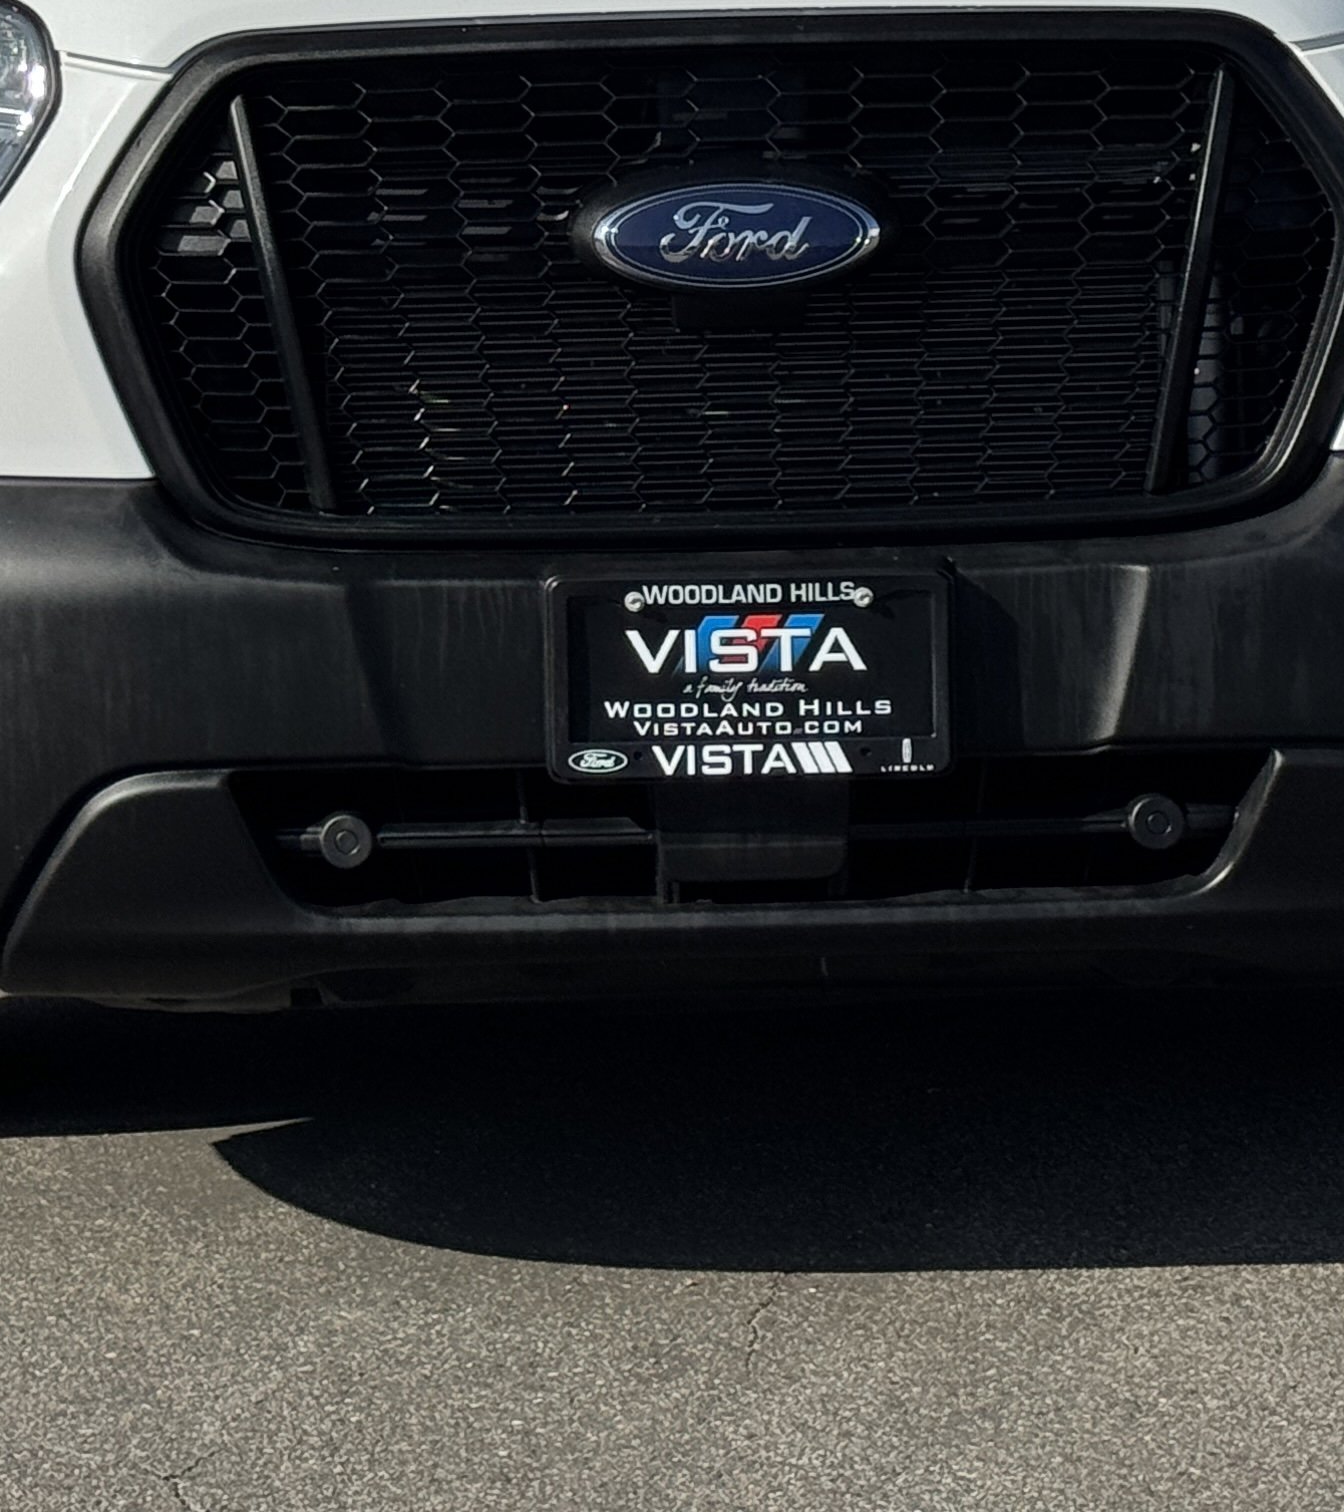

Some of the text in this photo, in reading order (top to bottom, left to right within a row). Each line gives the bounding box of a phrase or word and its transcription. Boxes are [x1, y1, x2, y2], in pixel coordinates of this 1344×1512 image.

[659, 201, 812, 263] Ford
[642, 581, 856, 605] WOODLAND HILLS
[625, 627, 868, 674] VISTA
[682, 675, 809, 702] a family tradition
[604, 699, 893, 719] WOODLAND HILLS
[579, 753, 616, 768] Ford
[651, 742, 797, 776] VISTA
